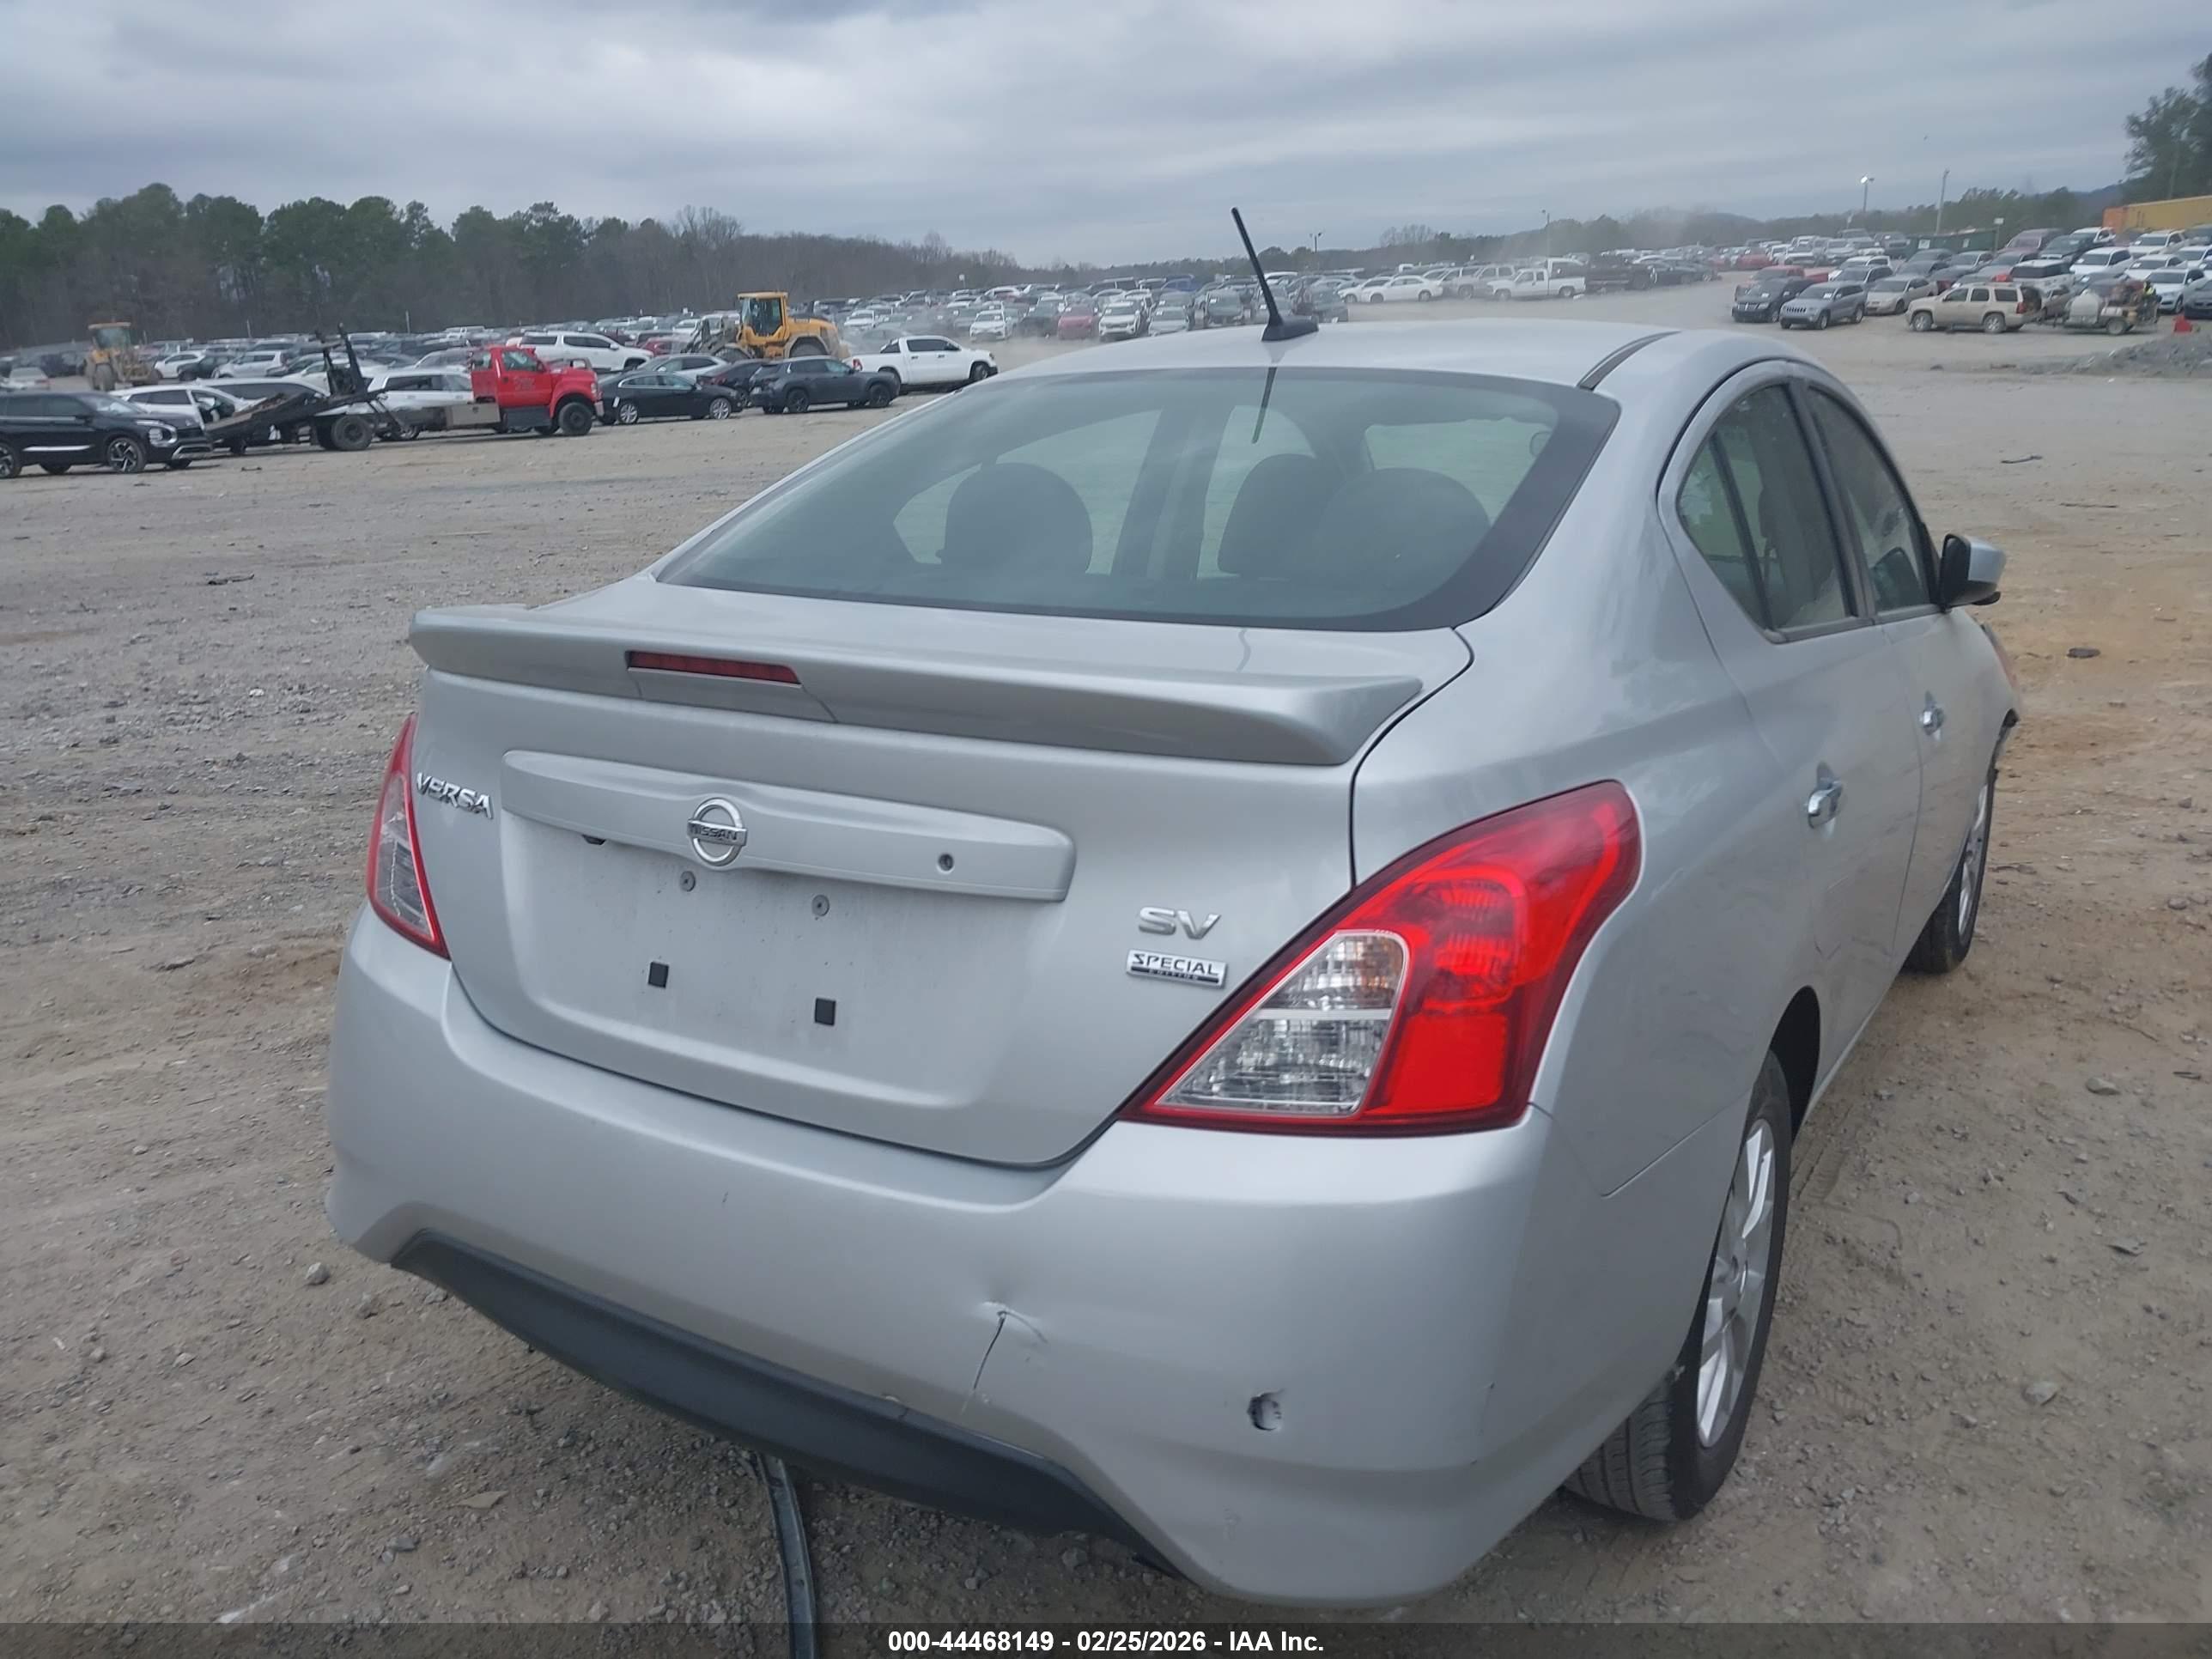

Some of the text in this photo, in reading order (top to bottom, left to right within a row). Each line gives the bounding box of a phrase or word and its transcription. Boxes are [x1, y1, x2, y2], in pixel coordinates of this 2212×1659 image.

[416, 772, 494, 820] VERSA
[689, 823, 738, 841] NISSAN
[1139, 906, 1221, 940] SV
[1131, 952, 1220, 977] SPECIAL
